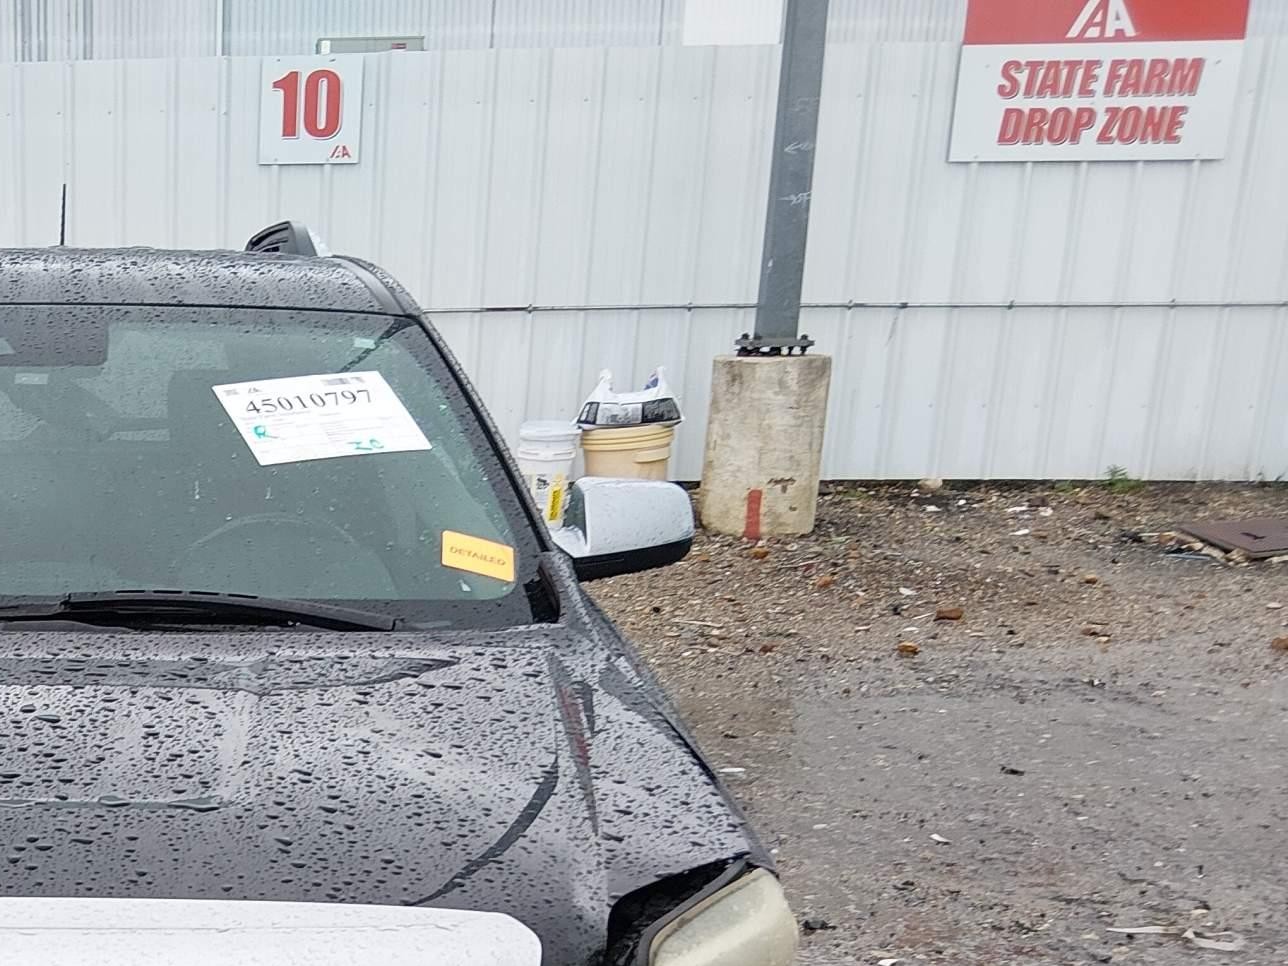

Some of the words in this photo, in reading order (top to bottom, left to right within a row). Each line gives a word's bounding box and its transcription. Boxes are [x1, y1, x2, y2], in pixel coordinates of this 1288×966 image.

[997, 60, 1102, 100] STATE
[1103, 57, 1206, 98] FARM
[272, 69, 343, 140] 10
[997, 107, 1096, 145] DROP
[1096, 105, 1188, 145] ZONE
[246, 388, 372, 414] 45010797
[449, 546, 506, 566] DETAILED
